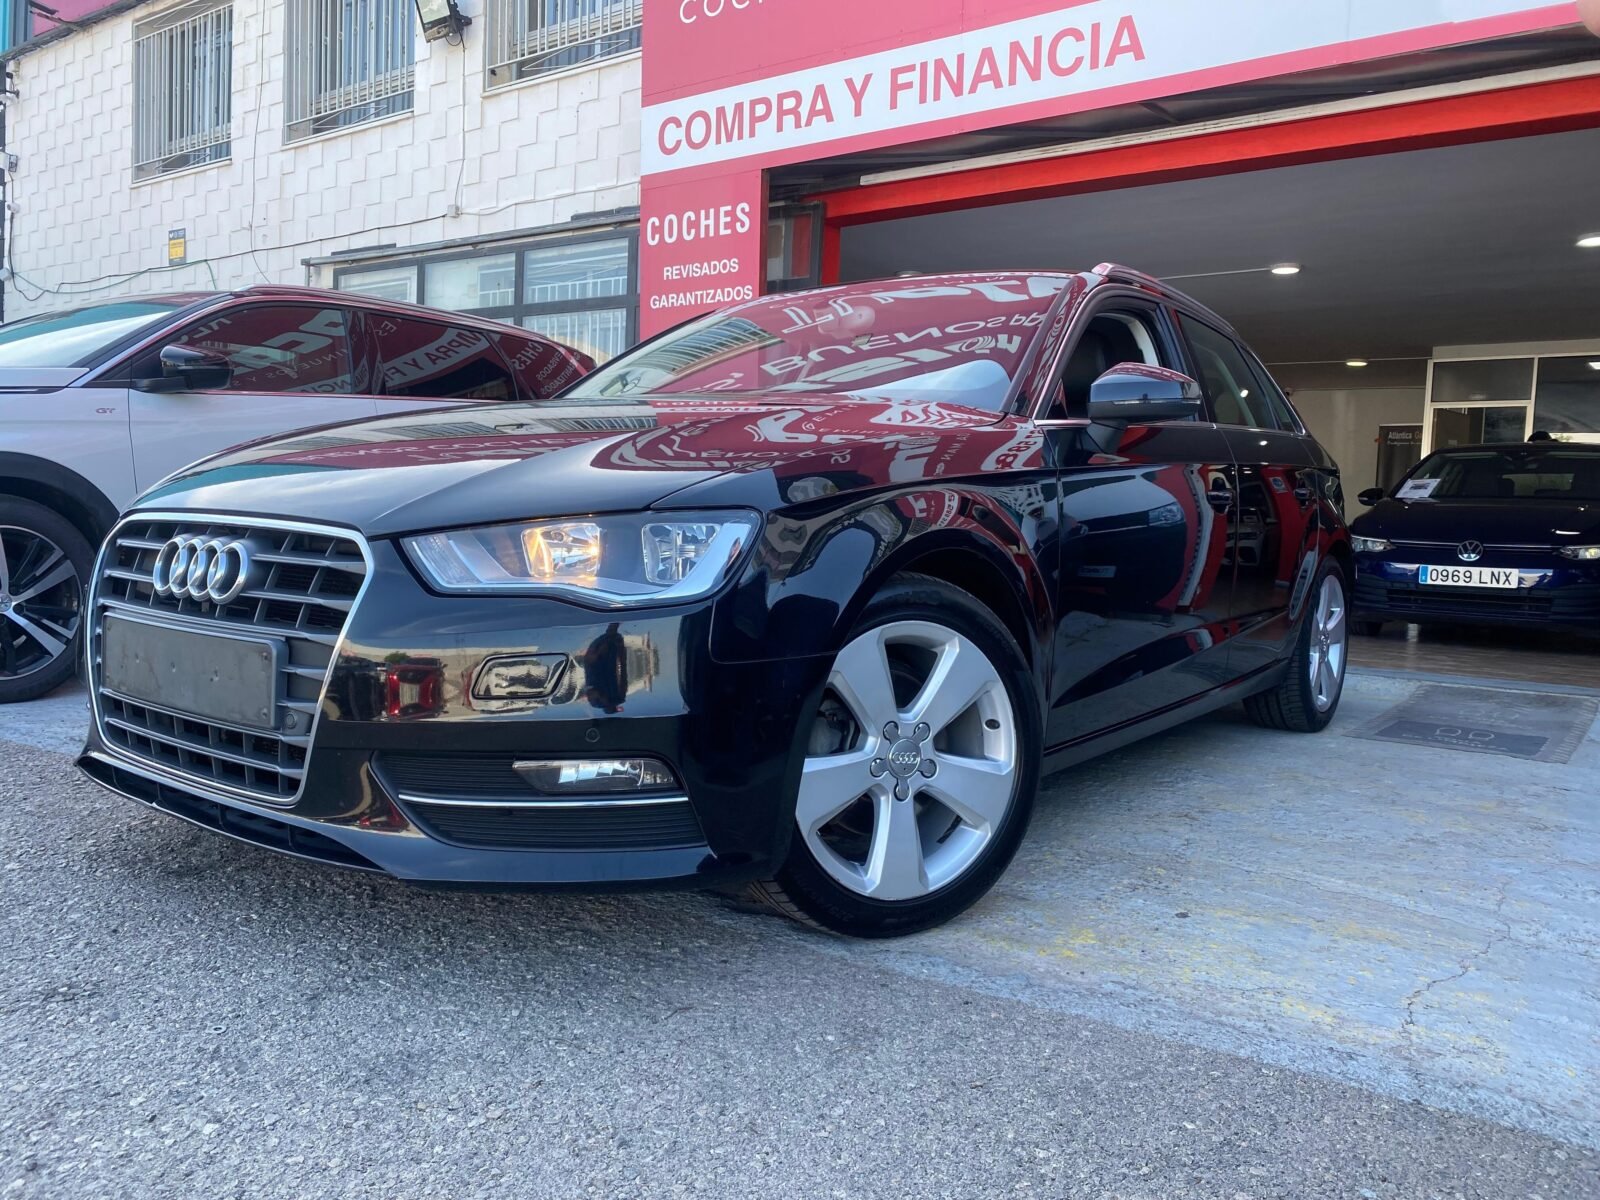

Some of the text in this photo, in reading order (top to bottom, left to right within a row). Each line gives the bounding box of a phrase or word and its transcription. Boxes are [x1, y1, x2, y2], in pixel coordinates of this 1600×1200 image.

[658, 15, 1146, 156] COMPRA Y FINANCIA
[646, 202, 750, 246] COCHES
[663, 258, 739, 281] REVISADOS
[650, 285, 753, 309] GARANTIZADOS
[1429, 568, 1513, 586] 0969 LNX
